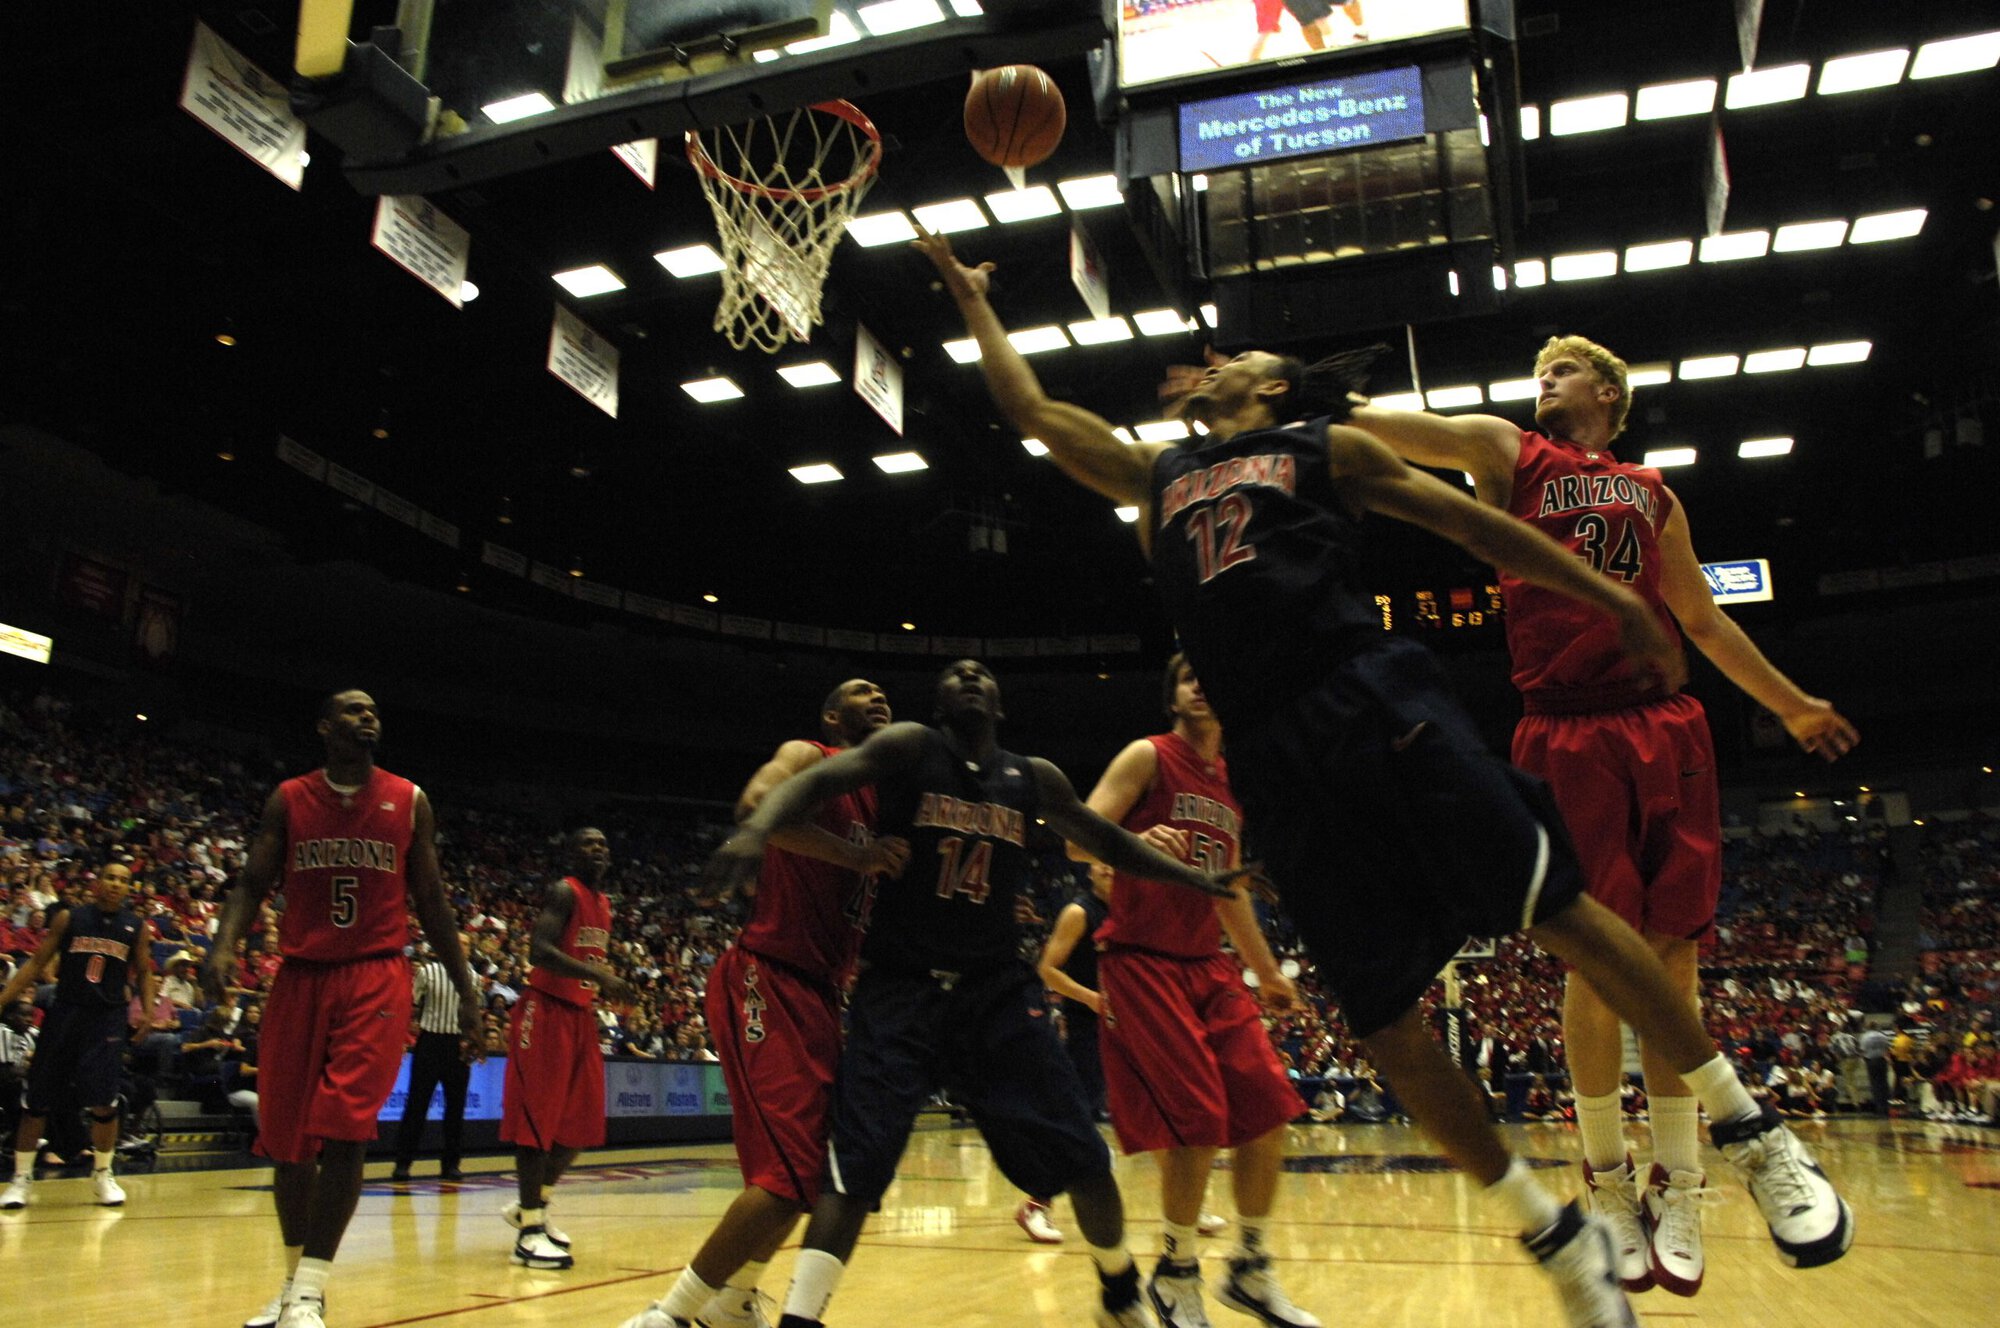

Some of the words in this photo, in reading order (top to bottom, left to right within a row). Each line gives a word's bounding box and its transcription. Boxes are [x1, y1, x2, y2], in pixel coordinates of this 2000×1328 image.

[1199, 94, 1408, 141] Mercedes-Benz
[1256, 94, 1294, 110] The
[1299, 86, 1343, 104] New
[1234, 134, 1263, 158] of
[1269, 123, 1371, 152] Tucson
[1161, 453, 1296, 530] ARIZONA
[1538, 474, 1659, 538] ARIZONA
[1184, 491, 1258, 585] 12
[1574, 513, 1643, 583] 34
[912, 791, 1026, 848] ARIZONA
[293, 837, 397, 874] ARIZONA
[936, 835, 993, 905] 14
[329, 875, 359, 928] 5
[743, 963, 768, 1043] CATS
